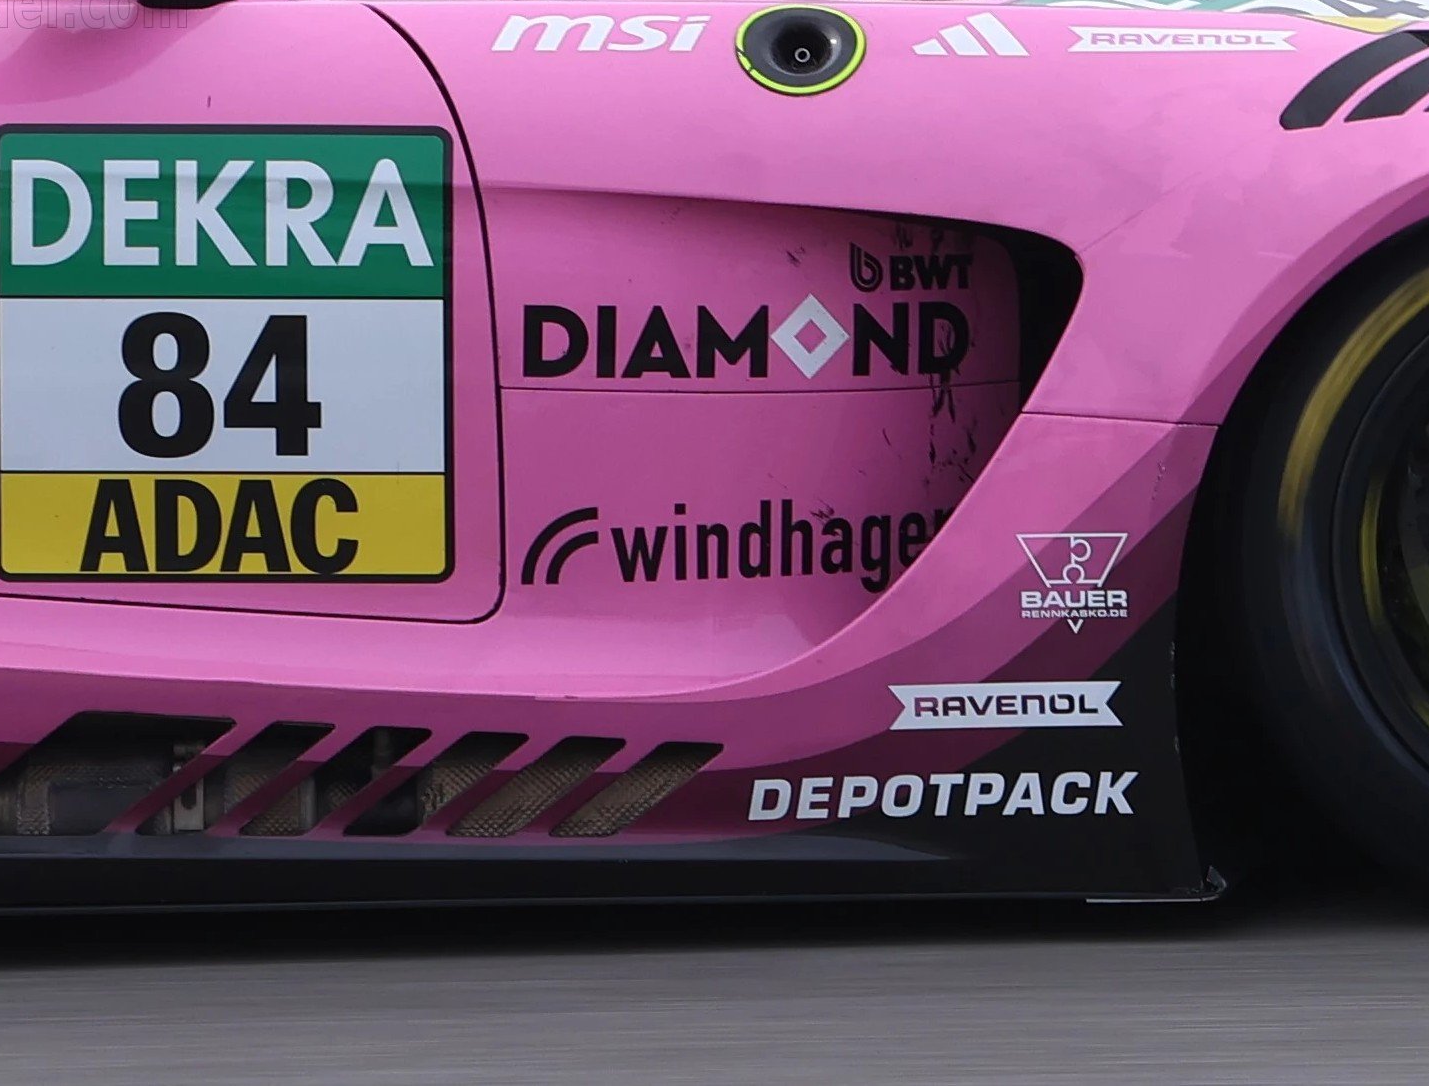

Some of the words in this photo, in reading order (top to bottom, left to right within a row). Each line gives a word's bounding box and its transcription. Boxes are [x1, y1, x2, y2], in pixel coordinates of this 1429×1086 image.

[492, 15, 712, 53] msi
[1089, 32, 1275, 48] RAVENOL
[10, 157, 434, 268] DEKRA
[890, 254, 974, 291] BWT
[116, 311, 321, 457] 84
[80, 478, 358, 576] ADAC
[1021, 590, 1128, 608] BAUER
[913, 693, 1098, 717] RAVENOL
[748, 770, 1139, 821] DEPOTPACK
